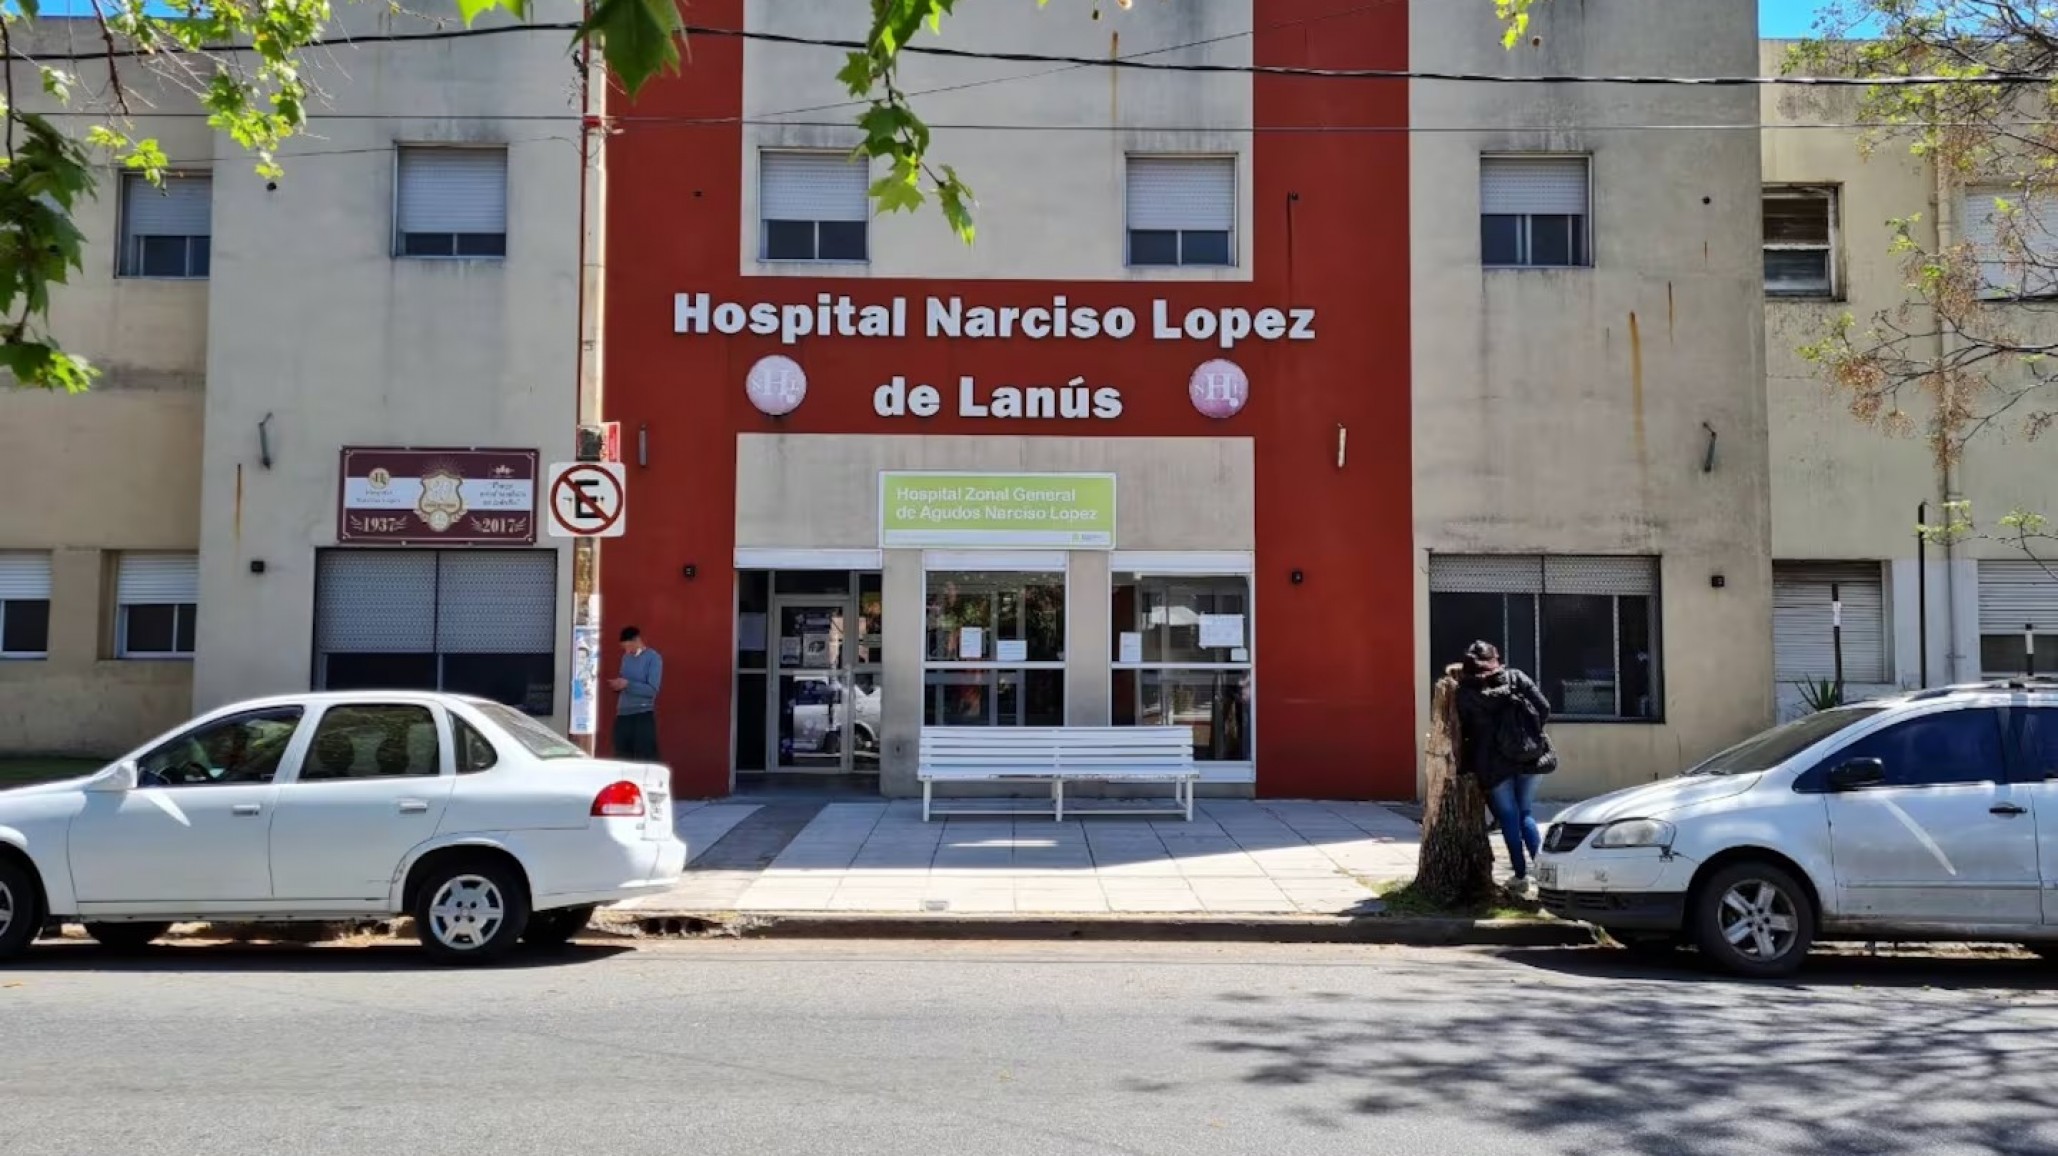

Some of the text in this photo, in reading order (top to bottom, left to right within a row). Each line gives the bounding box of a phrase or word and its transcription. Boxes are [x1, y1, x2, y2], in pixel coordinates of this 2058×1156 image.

[674, 292, 1316, 348] Hospital Narciso Lopez
[873, 376, 1123, 419] de Lanús
[576, 480, 602, 518] E
[895, 486, 1076, 505] Hospital Zonal General
[895, 505, 1098, 523] de Agudos Narciso Lopez
[363, 517, 397, 533] 1937
[482, 517, 515, 533] 2017
